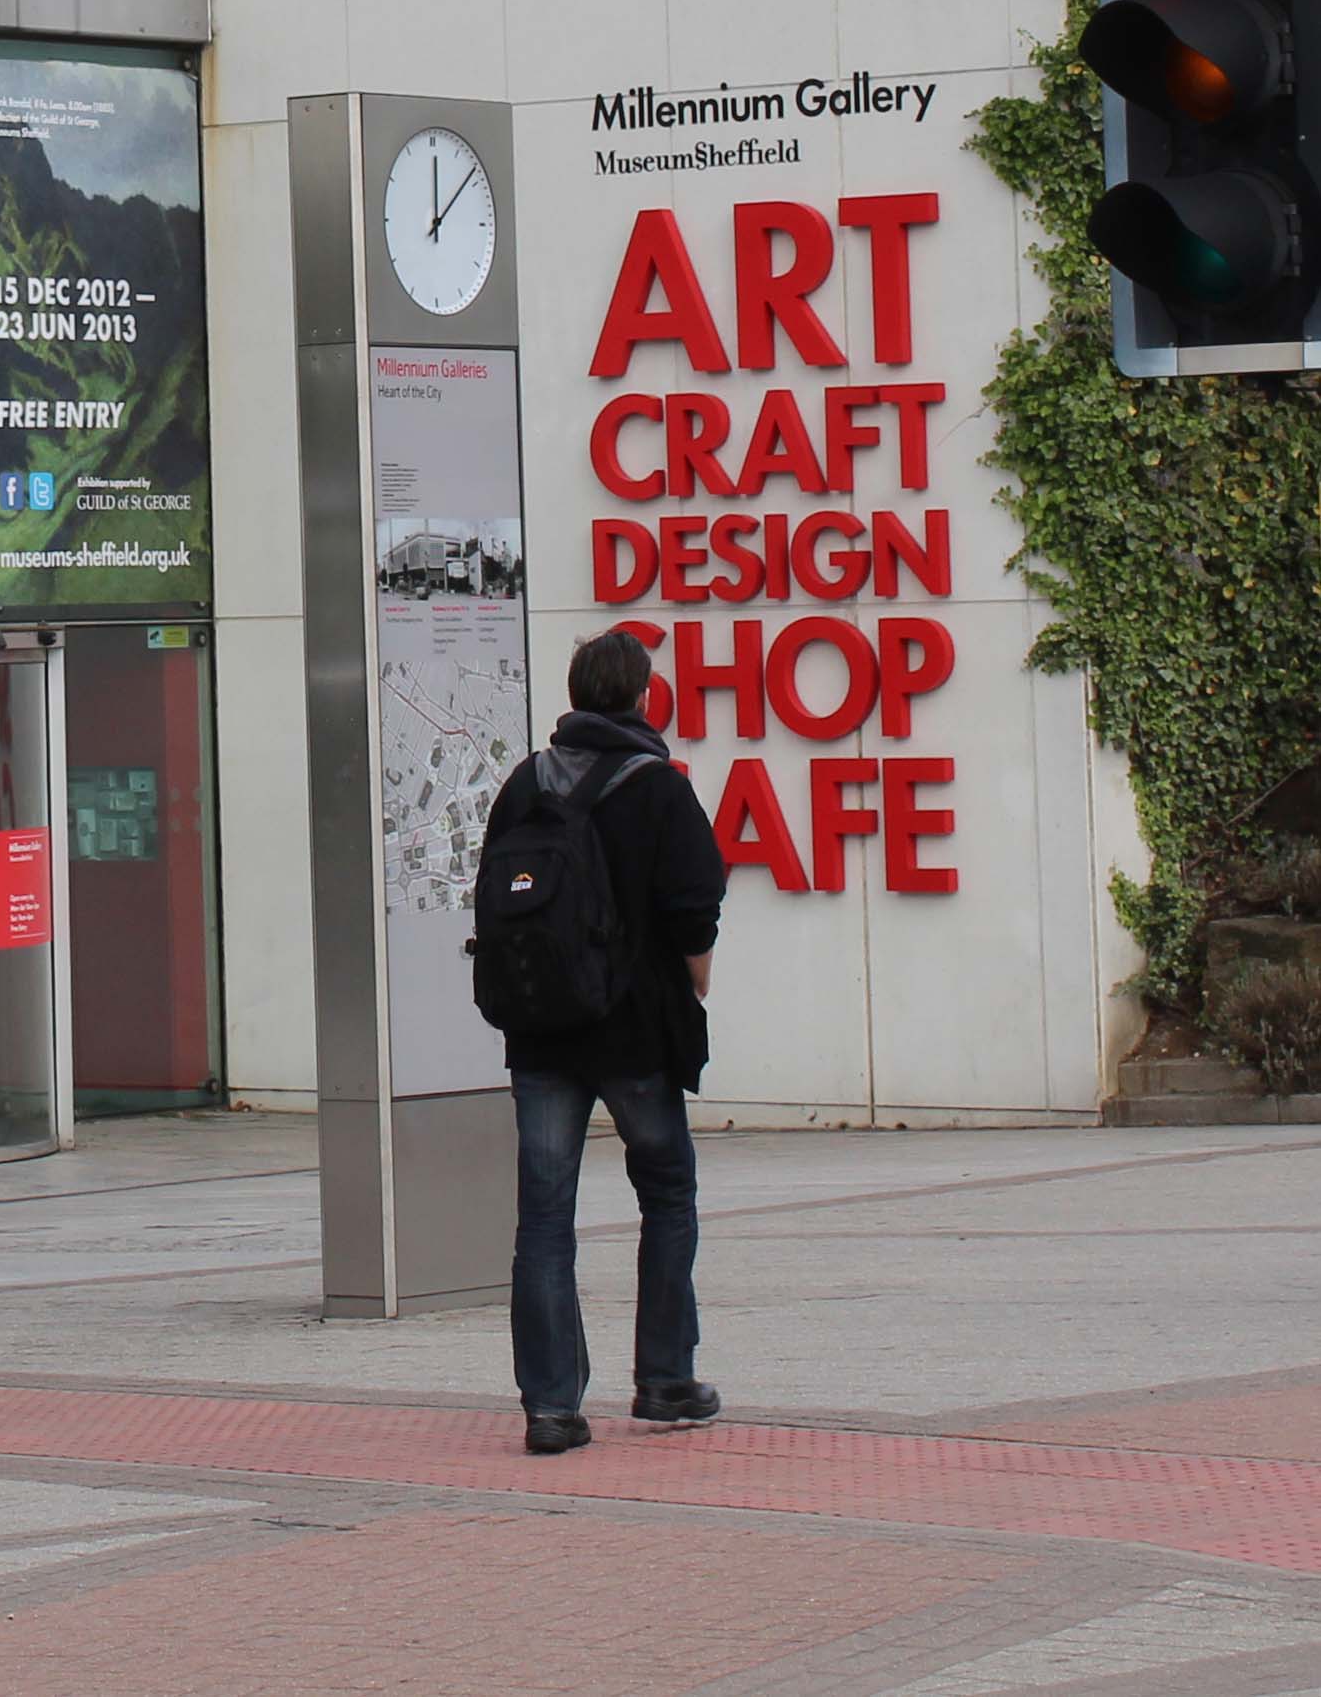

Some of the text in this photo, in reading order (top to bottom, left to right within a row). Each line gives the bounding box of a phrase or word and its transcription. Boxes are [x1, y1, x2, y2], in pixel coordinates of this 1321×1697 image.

[591, 71, 937, 131] Millennium Gallery
[27, 276, 71, 305] DEC
[76, 278, 131, 307] 2012
[588, 191, 941, 379] ART
[28, 312, 76, 341] JUN
[82, 313, 137, 343] 2013
[377, 357, 488, 380] Millennium Galleries
[377, 384, 443, 402] Heart of the City
[54, 401, 125, 429] ENTRY
[589, 382, 946, 501] CRAFT
[77, 476, 152, 491] Exhibition supported by
[76, 494, 191, 511] GUILD of St GEORGE
[0, 540, 191, 572] museums-sheffield.org.uk
[590, 508, 952, 604] DESIGN
[668, 757, 959, 893] AFE
